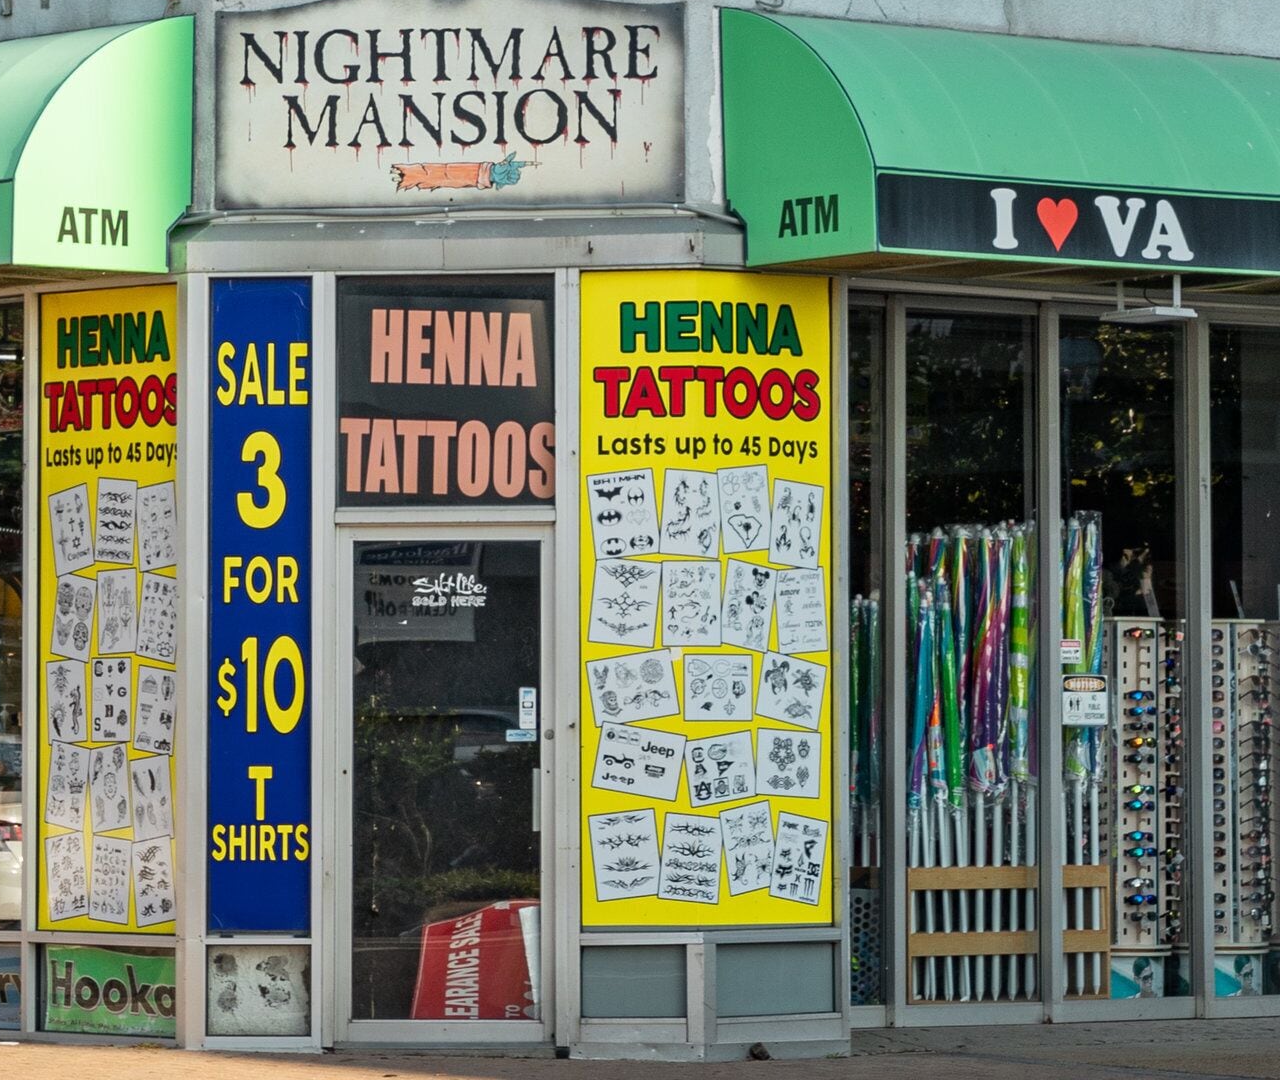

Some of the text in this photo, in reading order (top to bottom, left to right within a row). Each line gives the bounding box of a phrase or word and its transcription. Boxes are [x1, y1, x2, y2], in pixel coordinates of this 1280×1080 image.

[239, 26, 660, 85] NIGHTMARE
[282, 89, 622, 148] MANSION
[58, 206, 128, 246] ATM
[778, 194, 839, 238] ATM
[990, 188, 1194, 262] I VA
[57, 310, 170, 368] HENNA
[370, 308, 537, 387] HENNA
[620, 300, 803, 356] HENNA
[217, 341, 308, 406] SALE
[593, 366, 821, 421] TATTOOS
[45, 373, 176, 433] TATTOOS
[46, 444, 81, 467] Lasts
[86, 447, 103, 469] up
[108, 442, 122, 464] to
[126, 442, 142, 462] 45
[340, 418, 555, 498] TATTOOS
[598, 433, 818, 464] Lasts up to 45 Days
[236, 430, 288, 529] 3
[223, 556, 299, 604] FOR
[412, 595, 487, 608] SOLD HERE
[217, 635, 305, 734] $10
[641, 741, 675, 759] Jeep
[248, 766, 273, 821] T
[601, 773, 635, 786] Jeep
[211, 824, 310, 861] SHIRTS
[444, 947, 480, 1020] EARANCE
